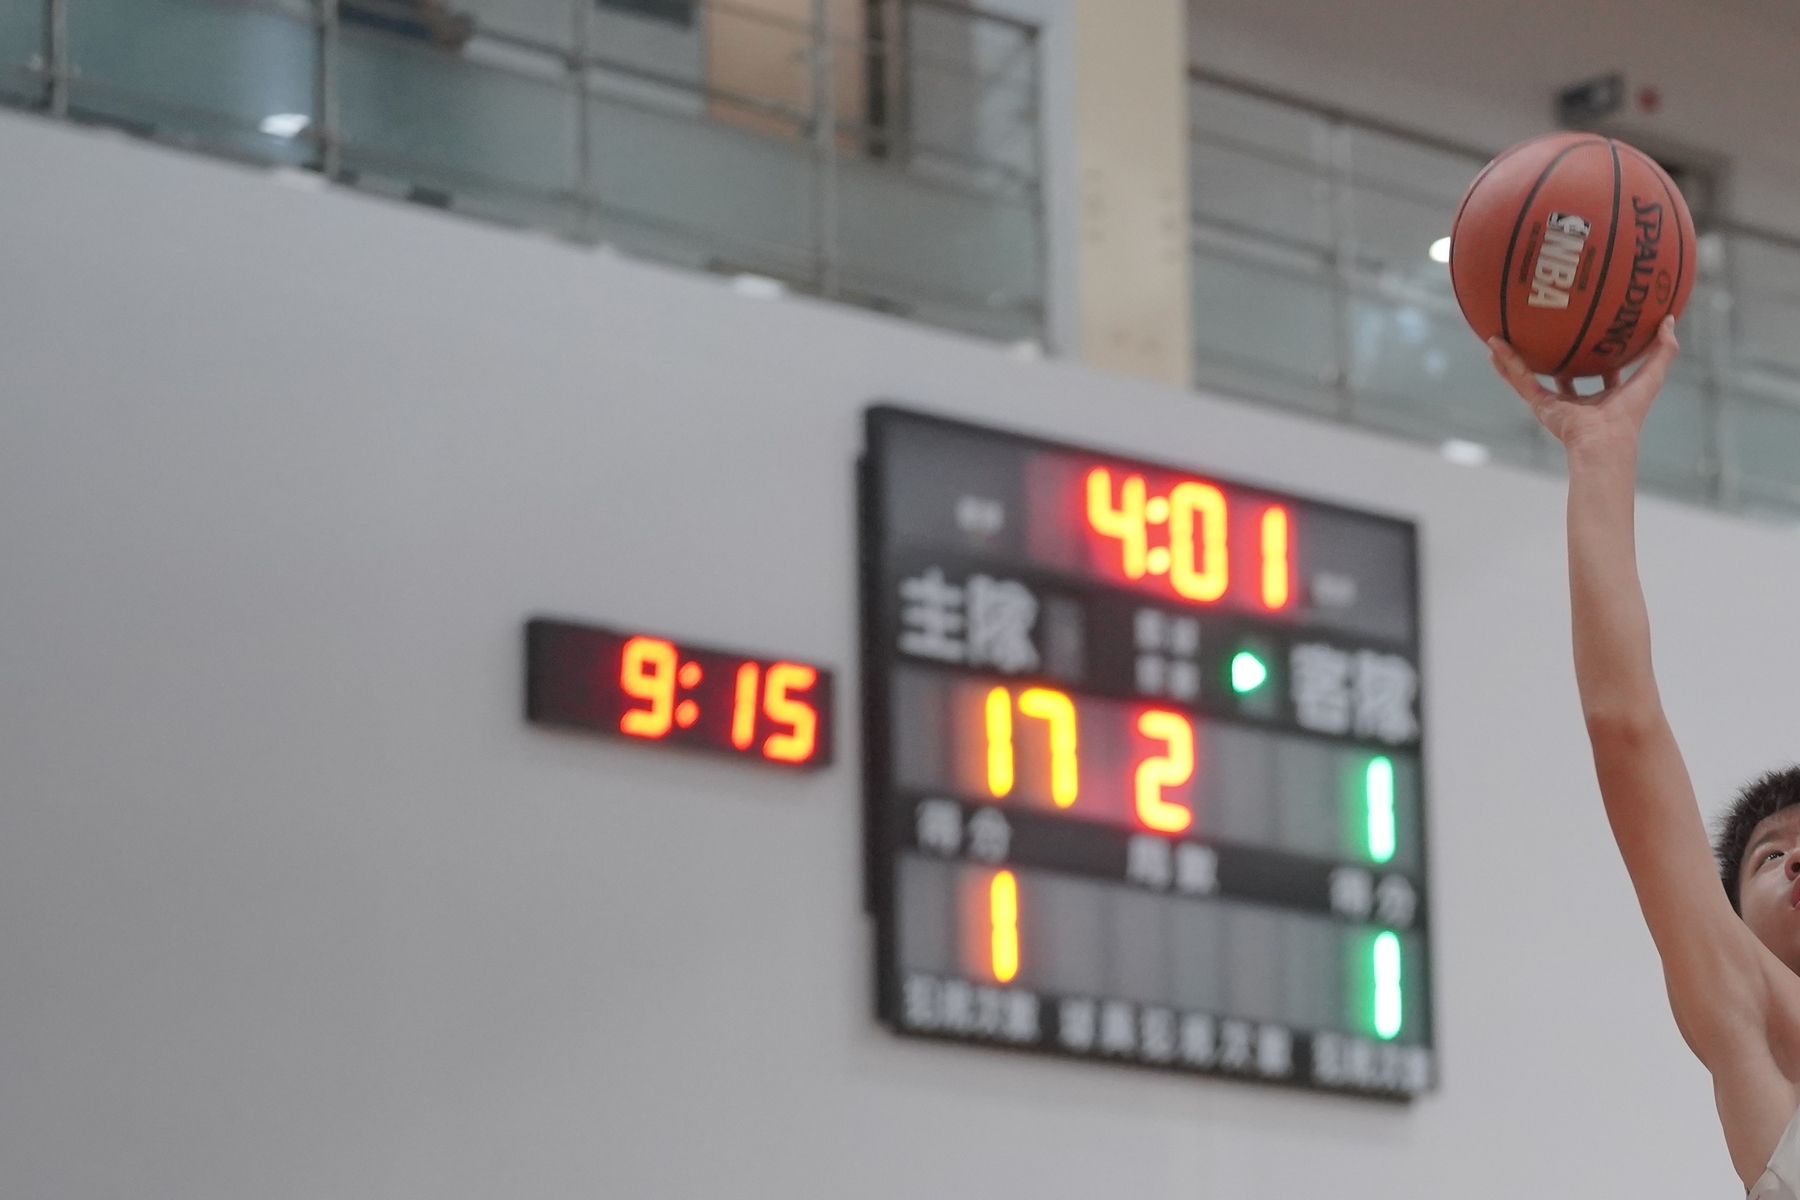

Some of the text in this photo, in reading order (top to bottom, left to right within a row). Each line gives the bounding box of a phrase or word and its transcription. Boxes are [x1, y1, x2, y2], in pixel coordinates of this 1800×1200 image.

[1528, 227, 1586, 310] NBA
[1594, 195, 1662, 355] SPALDING
[1086, 467, 1290, 610] 4:01
[897, 566, 1040, 673] 主隊
[620, 636, 818, 763] 9:15
[985, 686, 1078, 808] 17
[1135, 709, 1195, 833] 2
[1366, 755, 1396, 863] 1
[990, 869, 1019, 983] 1
[1373, 930, 1402, 1040] 1
